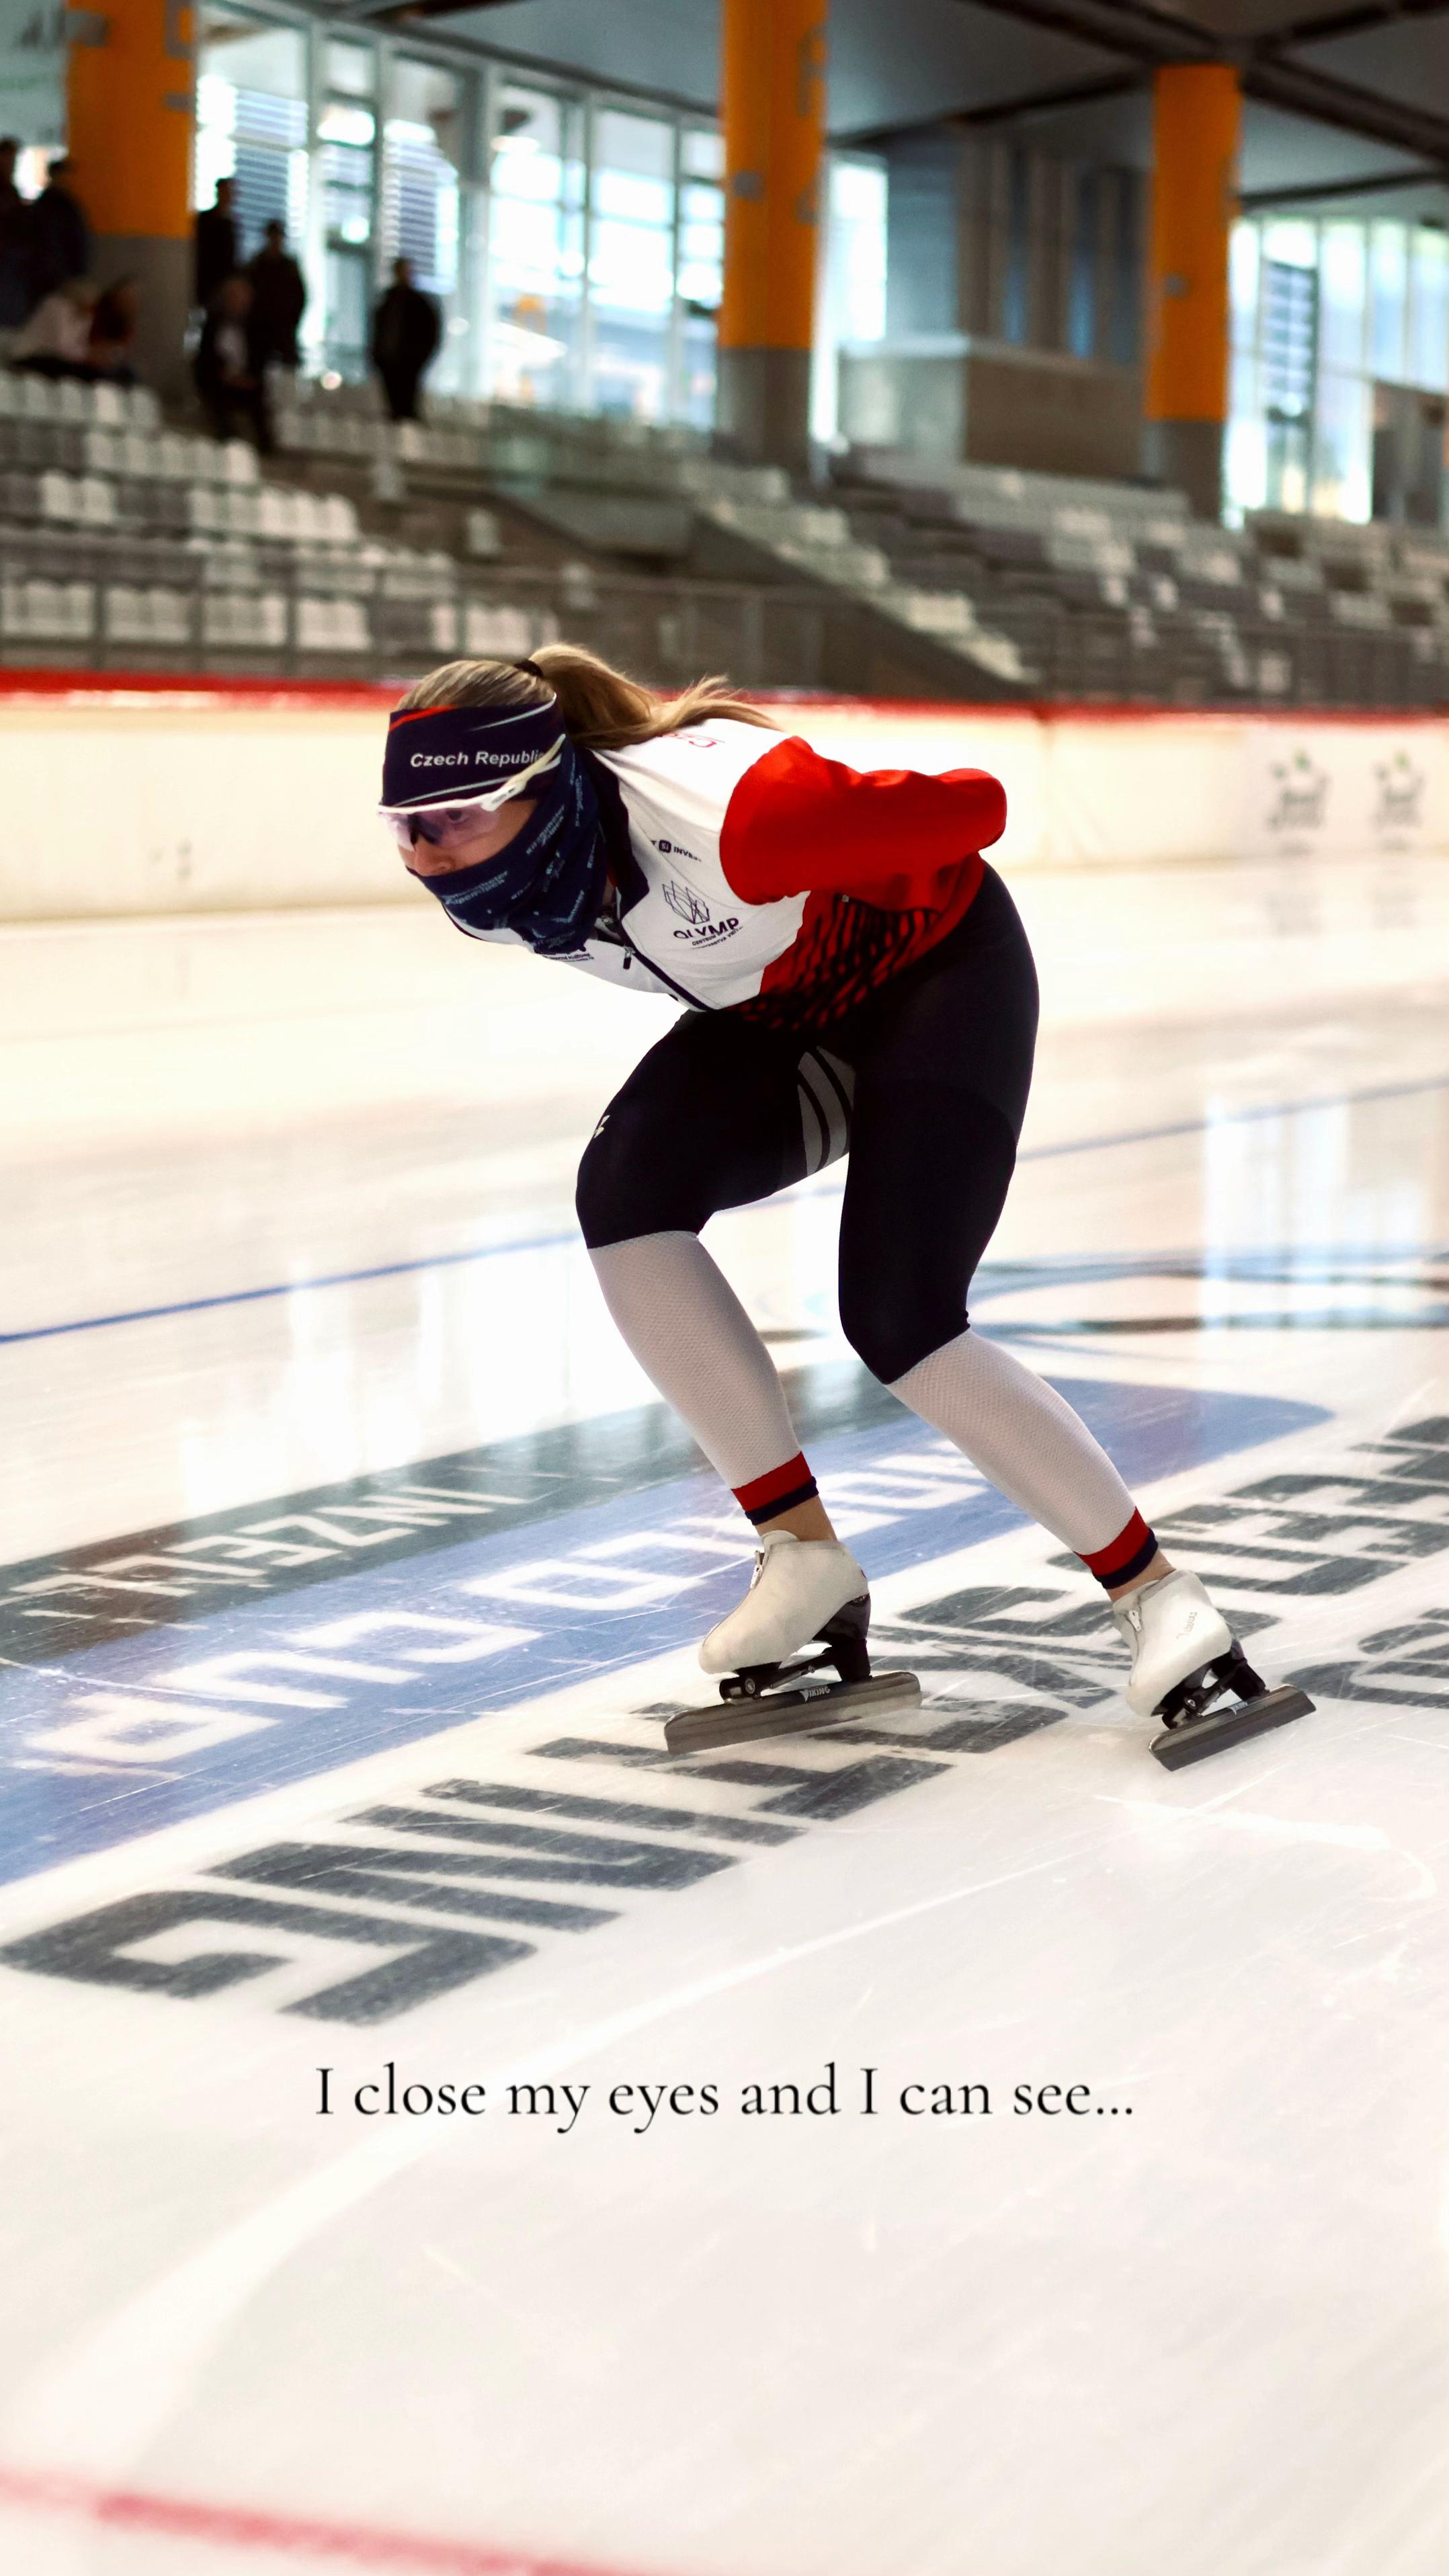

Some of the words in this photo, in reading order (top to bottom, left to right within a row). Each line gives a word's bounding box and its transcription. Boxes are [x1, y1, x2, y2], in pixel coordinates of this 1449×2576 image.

[410, 752, 468, 767] Czech
[673, 918, 739, 939] OLYMP
[9, 1486, 527, 1597] INZELL
[26, 1611, 543, 1763] CUP
[799, 1686, 831, 1702] VIKING
